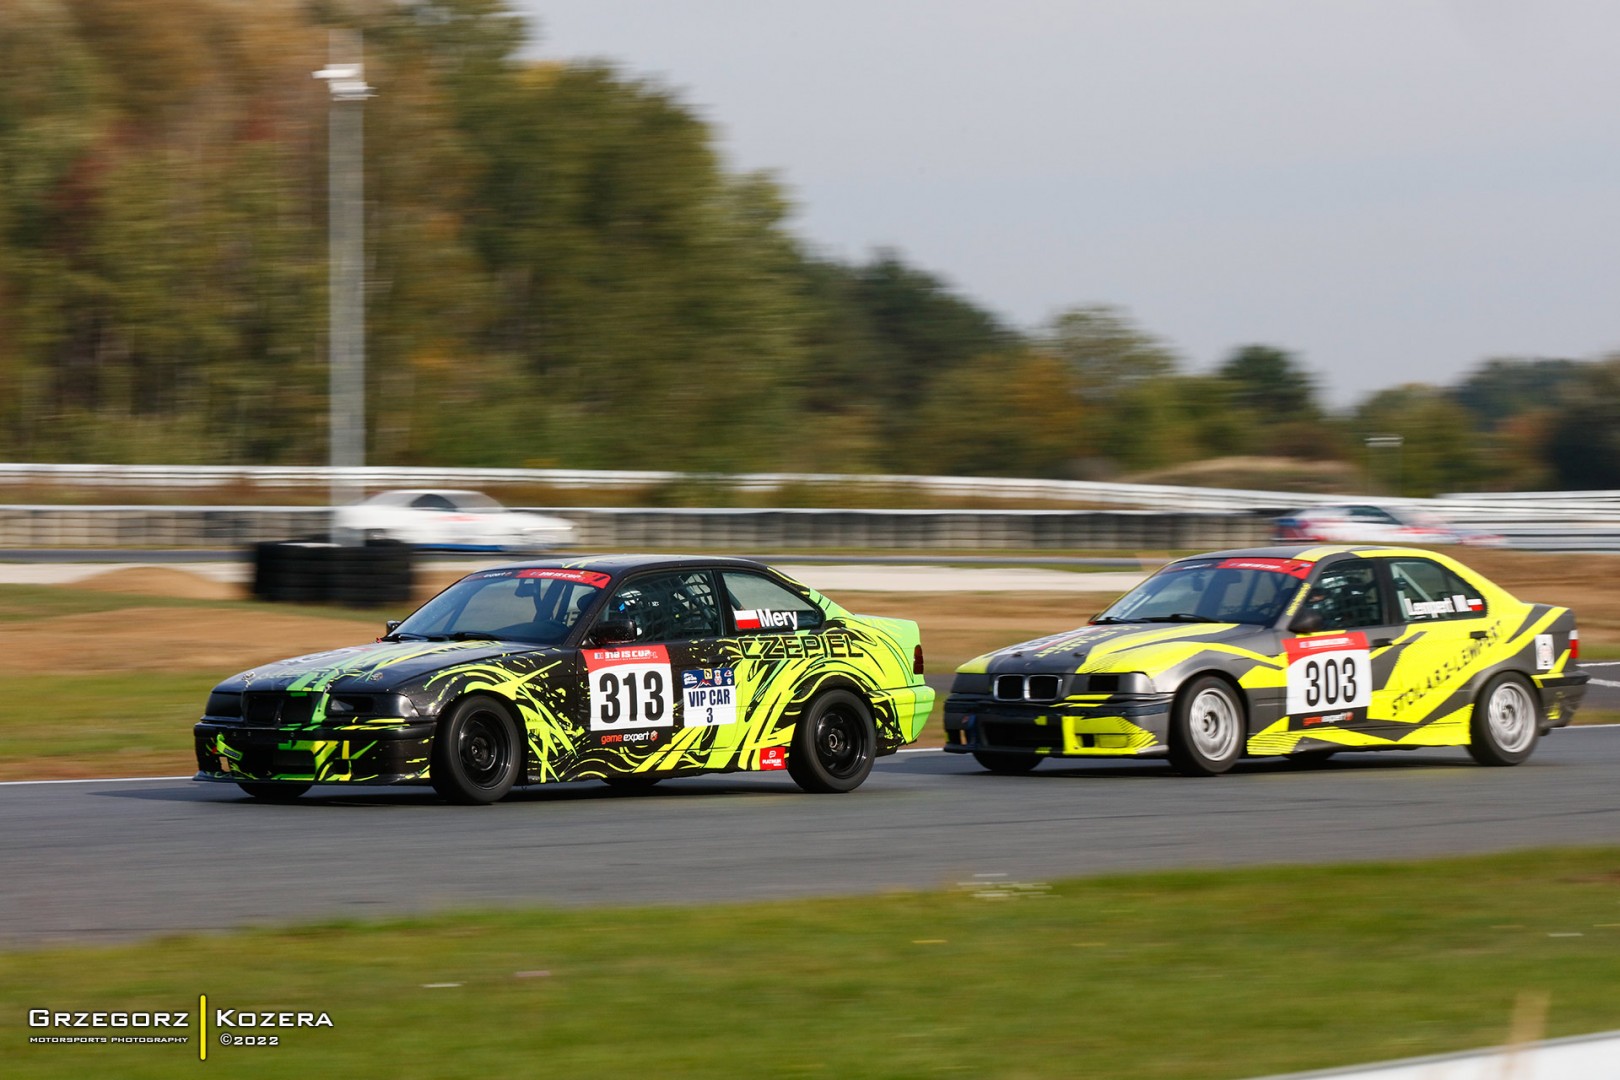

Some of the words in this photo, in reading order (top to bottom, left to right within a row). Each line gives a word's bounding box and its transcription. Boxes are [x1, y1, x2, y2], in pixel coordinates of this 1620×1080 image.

[757, 608, 798, 630] Mery
[737, 634, 864, 660] CZEPIEL
[1306, 657, 1356, 707] 303
[599, 670, 665, 724] 313
[688, 690, 706, 707] VIP
[709, 688, 730, 706] CAR
[706, 707, 714, 723] 3
[601, 734, 623, 745] game
[623, 730, 650, 743] expert
